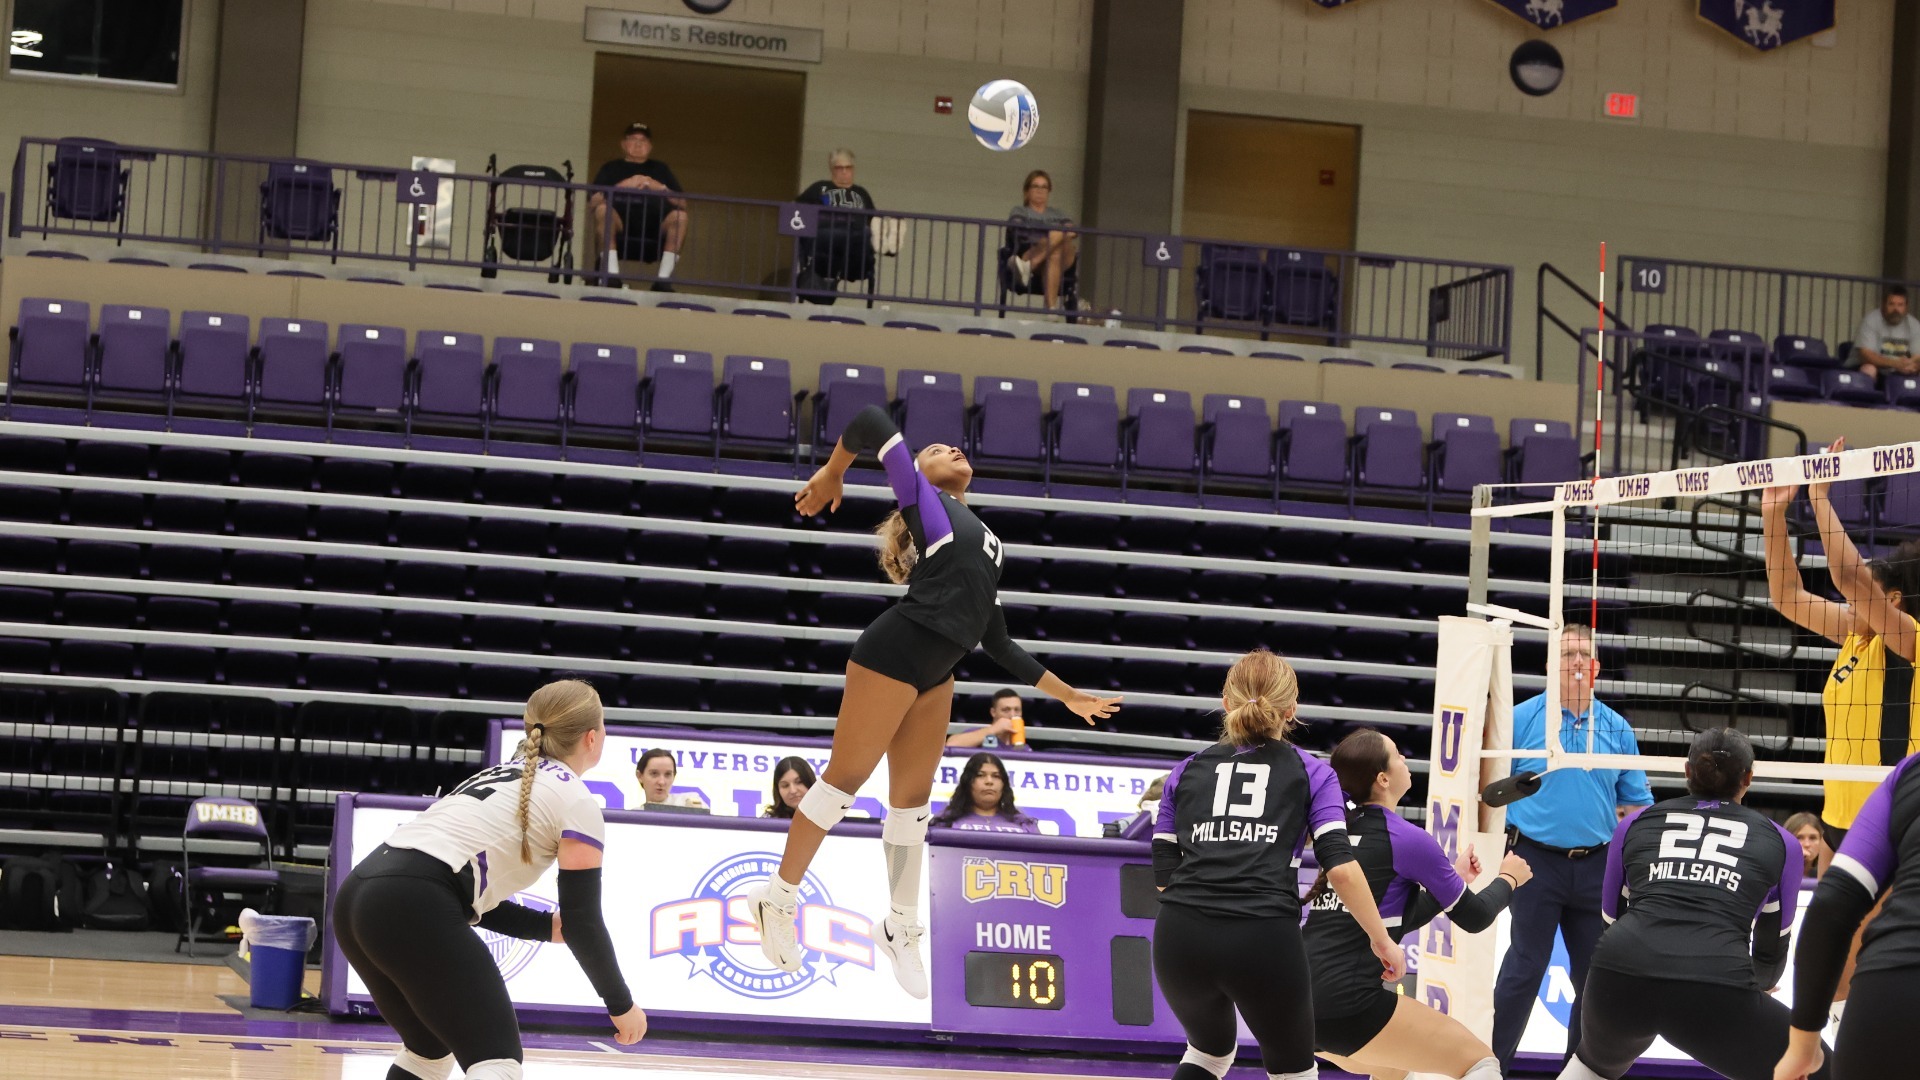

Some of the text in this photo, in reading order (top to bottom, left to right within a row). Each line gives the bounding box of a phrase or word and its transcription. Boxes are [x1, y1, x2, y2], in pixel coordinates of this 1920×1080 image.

[620, 19, 788, 52] Men's Restroom
[1607, 93, 1637, 118] EXIT
[1638, 268, 1662, 289] 10
[1618, 477, 1650, 498] UMHB
[1676, 471, 1709, 493] UMHB
[1737, 463, 1774, 486] UMHB
[1802, 456, 1841, 480] UMHB
[1872, 446, 1915, 472] UMHB
[630, 747, 829, 776] UIVERSY
[1212, 762, 1271, 818] 13
[195, 802, 259, 827] UMHB
[1191, 820, 1279, 844] MILLSAPS
[1658, 812, 1749, 868] 22
[963, 856, 988, 867] THE
[709, 861, 759, 893] AMERICAN
[964, 860, 1067, 908] CRU
[1648, 861, 1742, 893] MILLSAPS
[976, 922, 1052, 951] HOME
[716, 961, 809, 990] CONFERENCE
[1012, 960, 1056, 1005] 10
